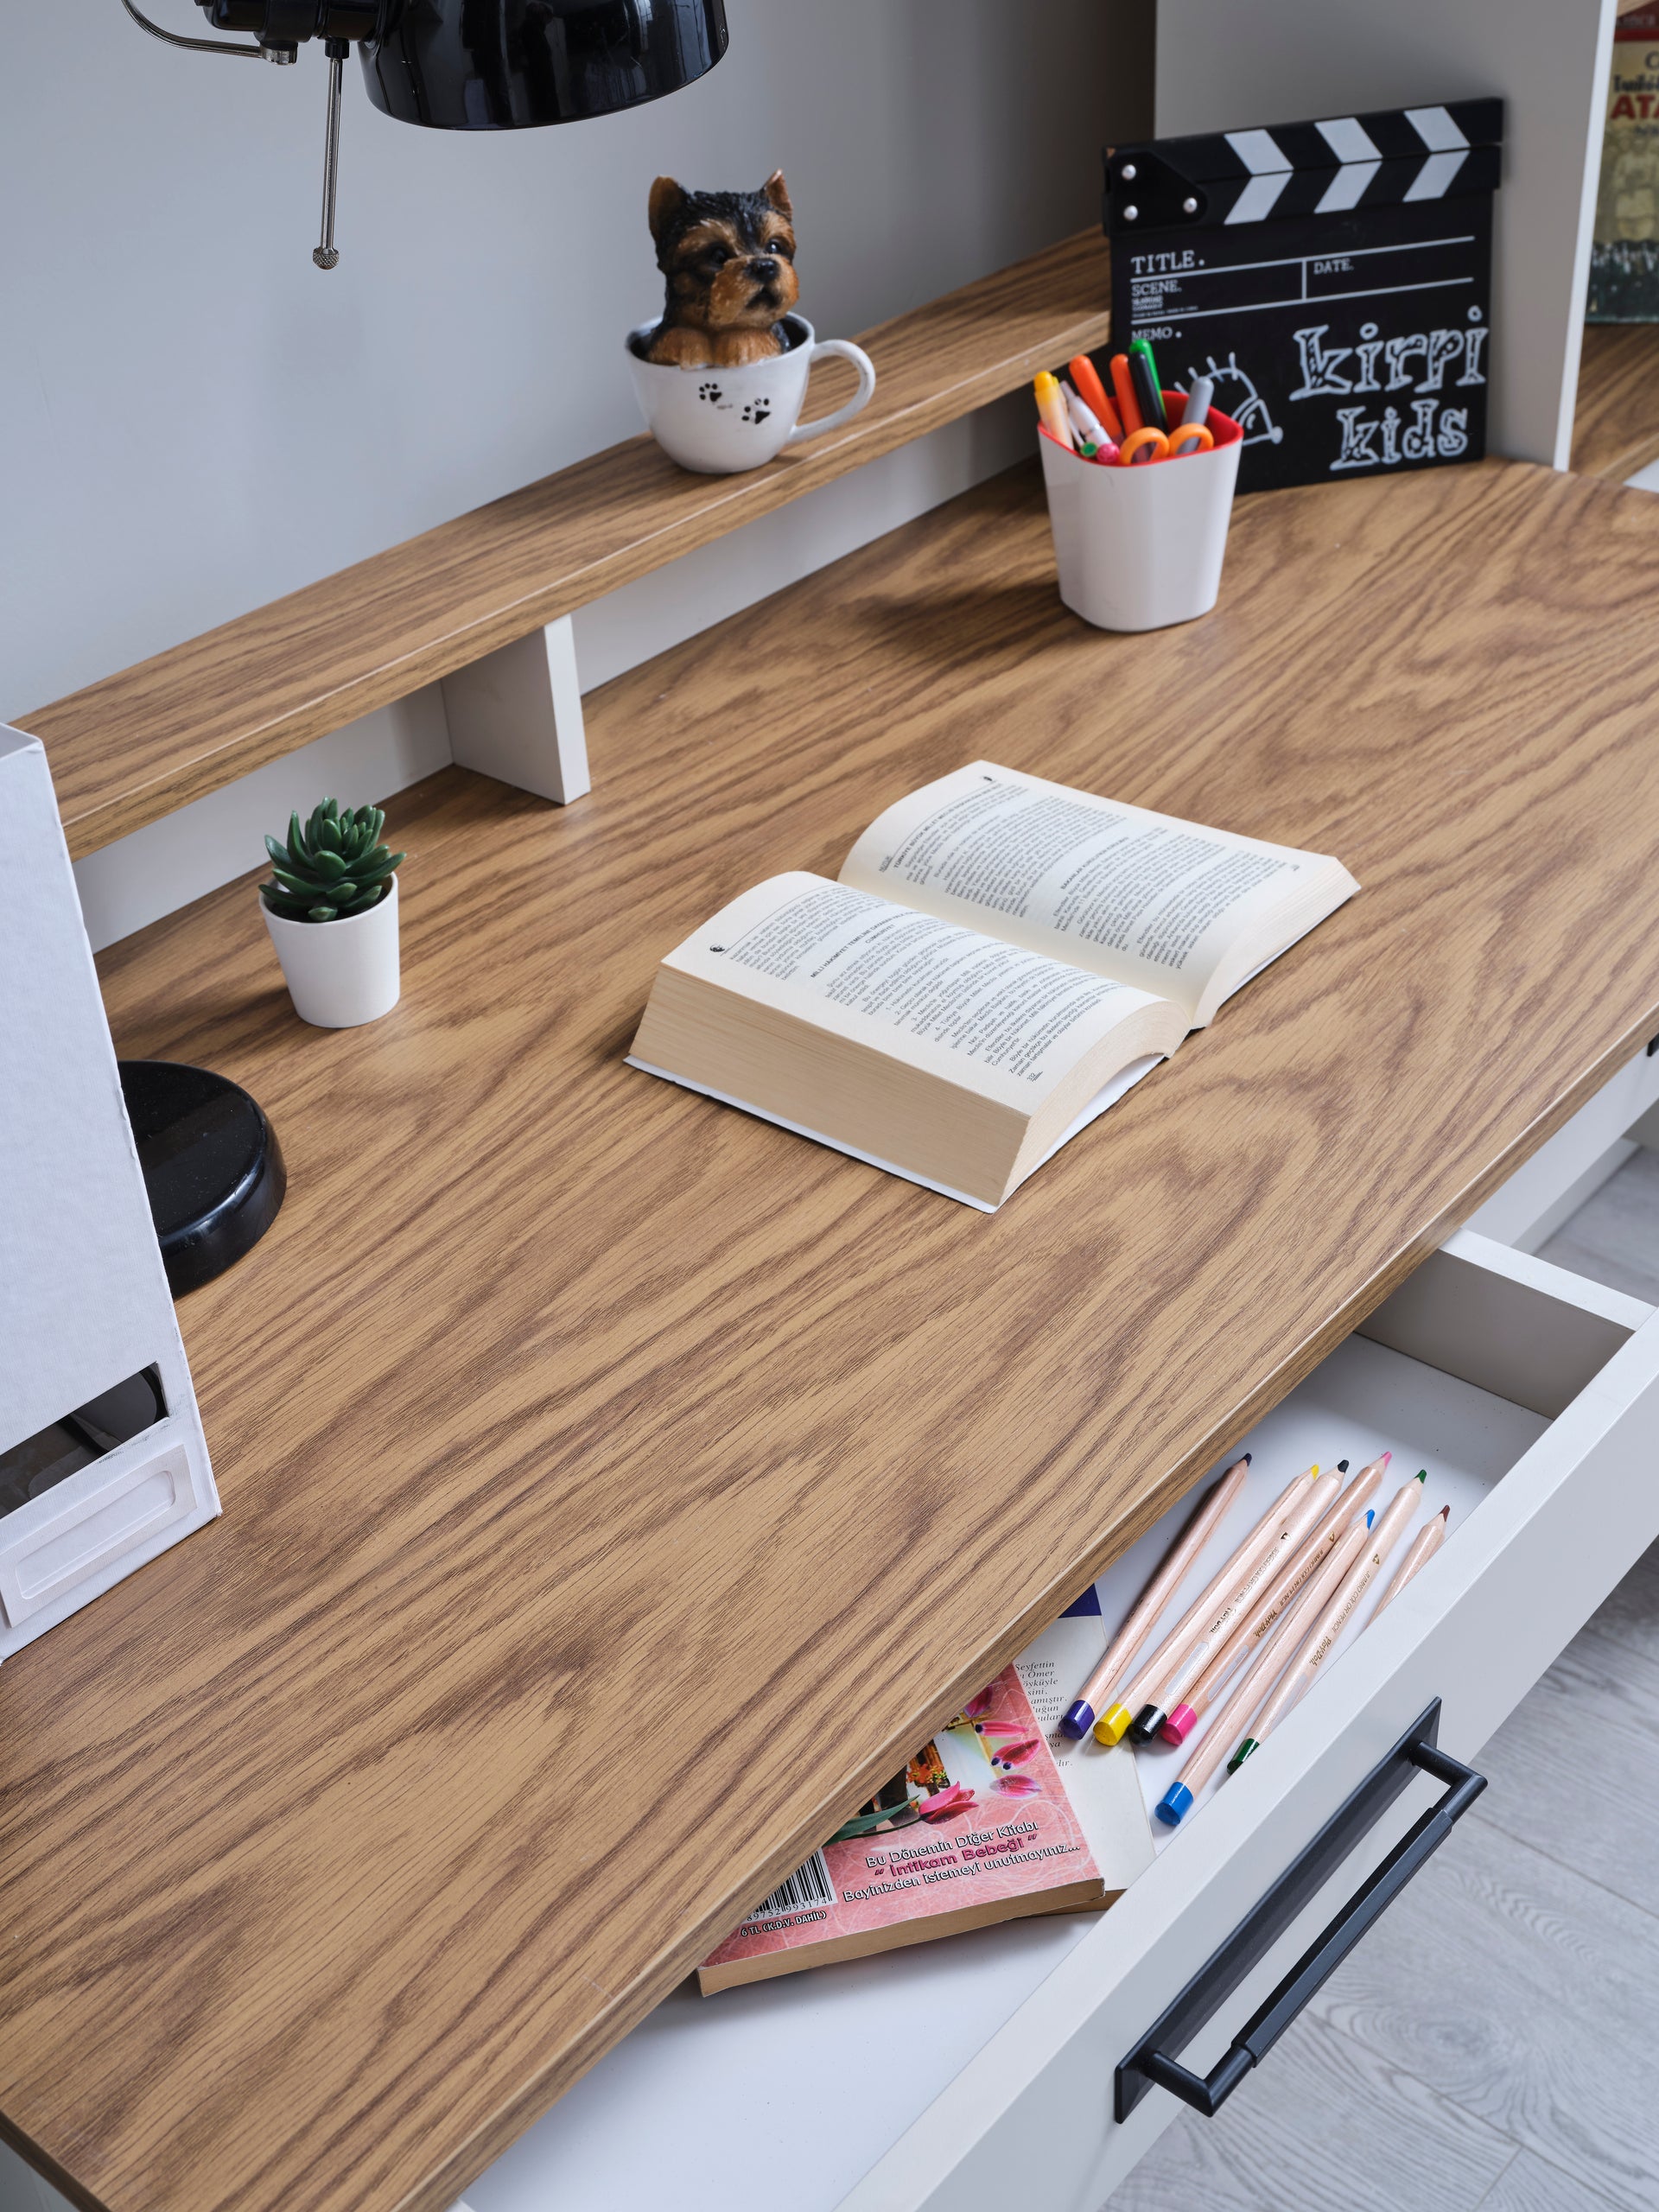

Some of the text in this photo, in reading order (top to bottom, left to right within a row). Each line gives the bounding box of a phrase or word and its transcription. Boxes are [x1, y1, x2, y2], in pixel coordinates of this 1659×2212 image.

[1289, 305, 1489, 401] kirpi
[1329, 398, 1468, 471] kids
[1015, 1662, 1054, 1672] Seyfettin
[1028, 1669, 1054, 1679] Ömer
[1030, 1696, 1068, 1706] amıştır.
[866, 1821, 1039, 1868] Bu Dönemin Diğer Kitabı
[842, 1877, 921, 1903] Bayinizden
[923, 1861, 982, 1885] istemeyi
[741, 1928, 748, 1936] 6
[749, 1926, 761, 1936] TL
